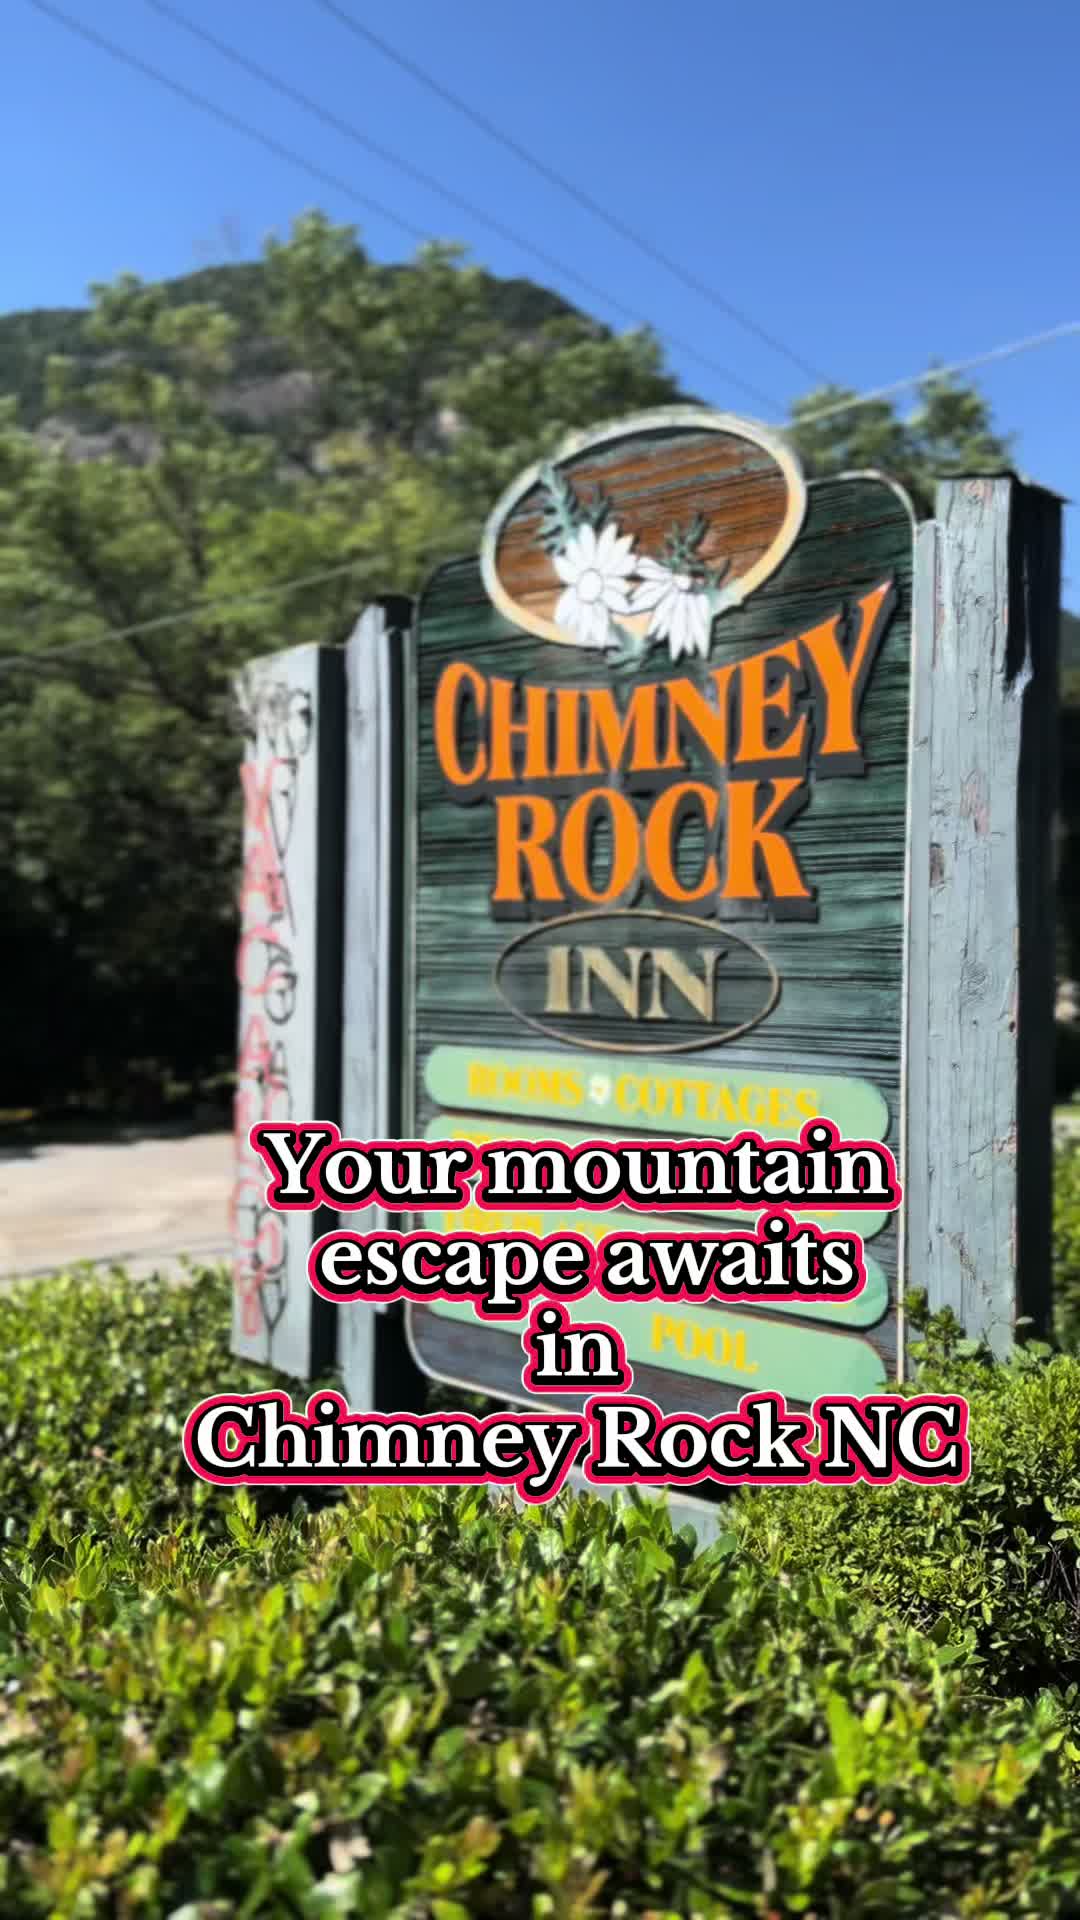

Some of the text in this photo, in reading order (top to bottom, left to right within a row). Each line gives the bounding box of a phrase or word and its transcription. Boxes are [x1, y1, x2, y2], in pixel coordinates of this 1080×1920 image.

[433, 580, 893, 787] CHIMNEY
[492, 776, 812, 902] ROCK
[543, 944, 728, 1023] INN
[467, 1062, 821, 1128] ROOMS COTTAGES
[650, 1312, 760, 1375] POOL
